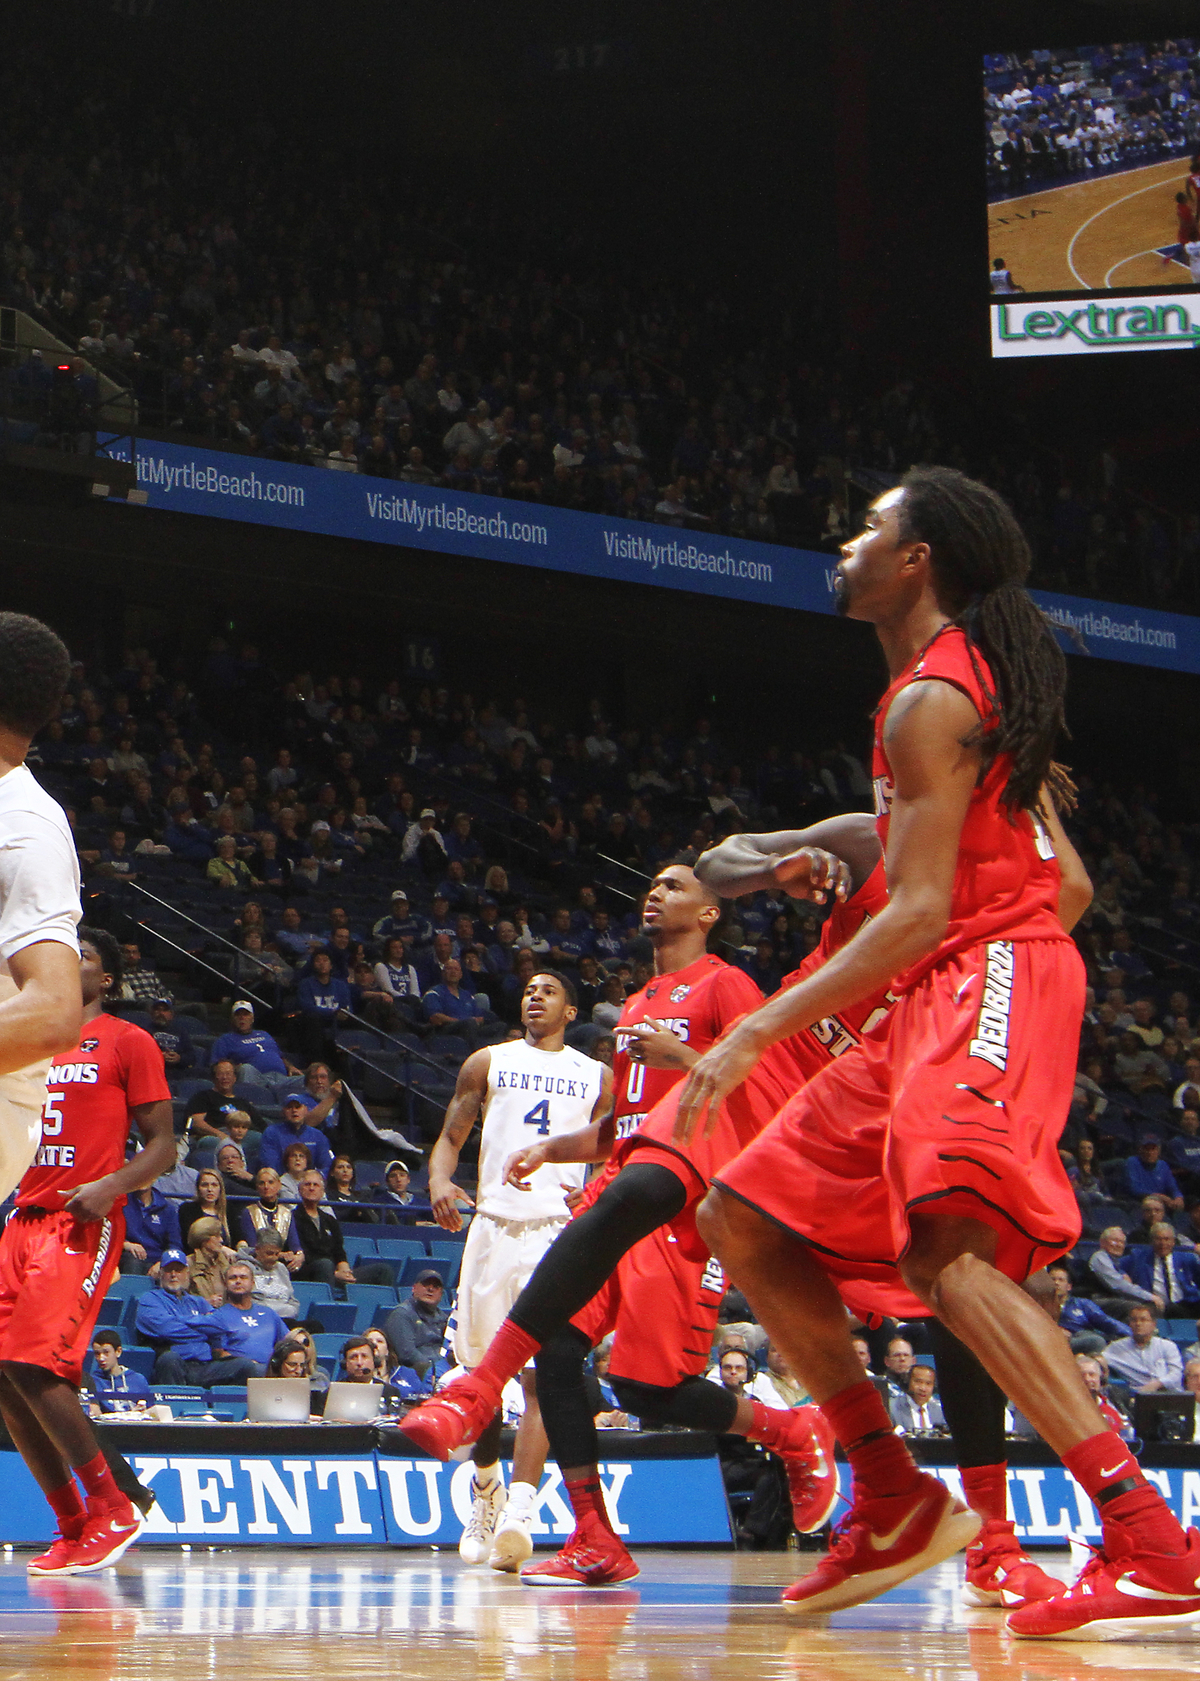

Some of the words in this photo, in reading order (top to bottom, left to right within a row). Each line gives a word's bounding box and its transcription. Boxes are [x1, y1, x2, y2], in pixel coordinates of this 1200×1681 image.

[998, 302, 1188, 344] Lextran
[109, 451, 305, 508] itMyrtleBeach.com
[366, 492, 548, 546] VisitMyrtleBeach.com
[604, 531, 772, 583] VisitMyrtleBeach.com
[408, 644, 435, 670] 16
[968, 940, 1015, 1073] REDBIRD
[497, 1071, 589, 1099] KENTUCKY
[43, 1092, 65, 1136] 5
[523, 1099, 551, 1135] 4
